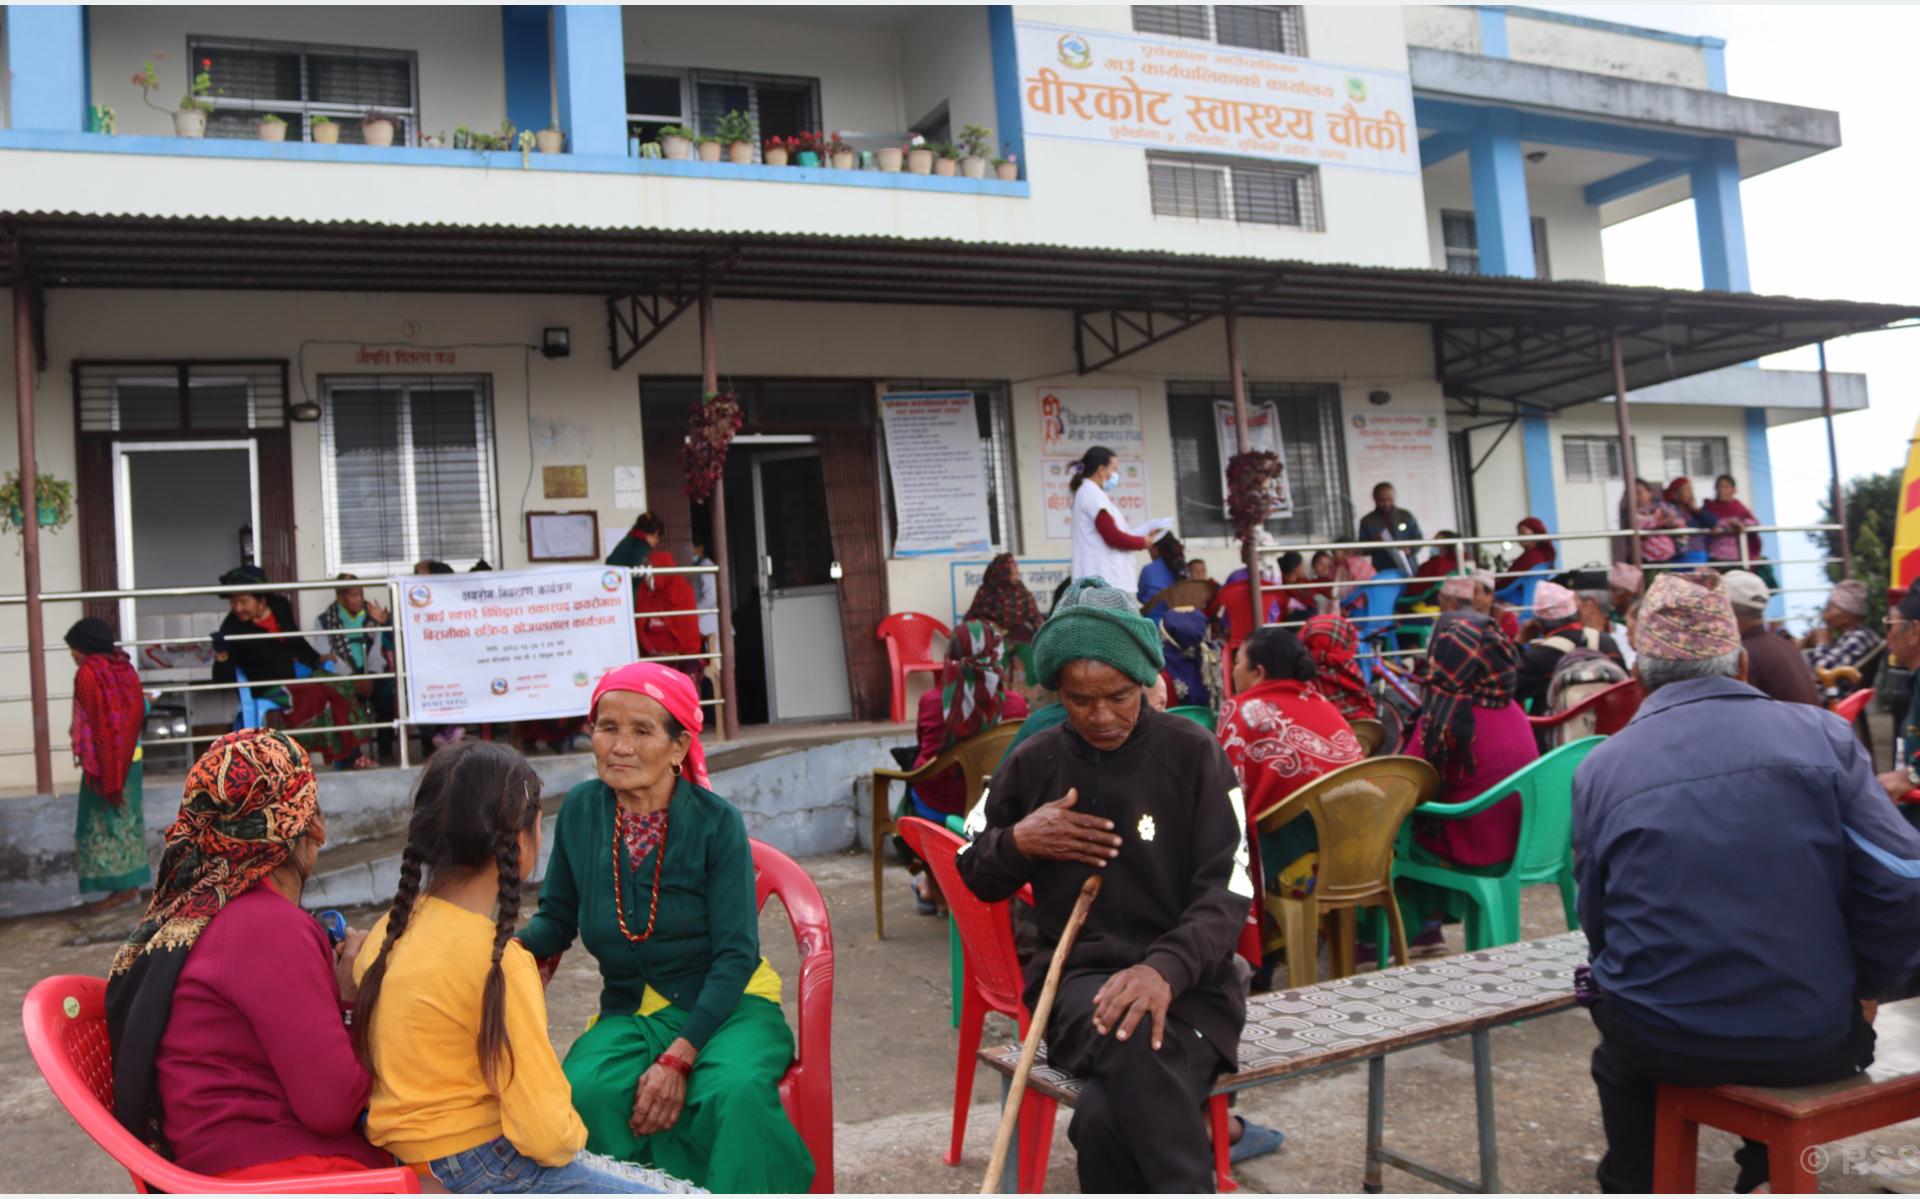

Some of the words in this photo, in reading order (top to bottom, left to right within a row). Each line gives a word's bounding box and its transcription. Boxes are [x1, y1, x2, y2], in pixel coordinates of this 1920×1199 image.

[1026, 67, 1172, 126] वीरकोट
[1184, 95, 1314, 142] स्वास्थ्य
[1325, 102, 1408, 153] चौकी
[1120, 496, 1143, 509] OTC
